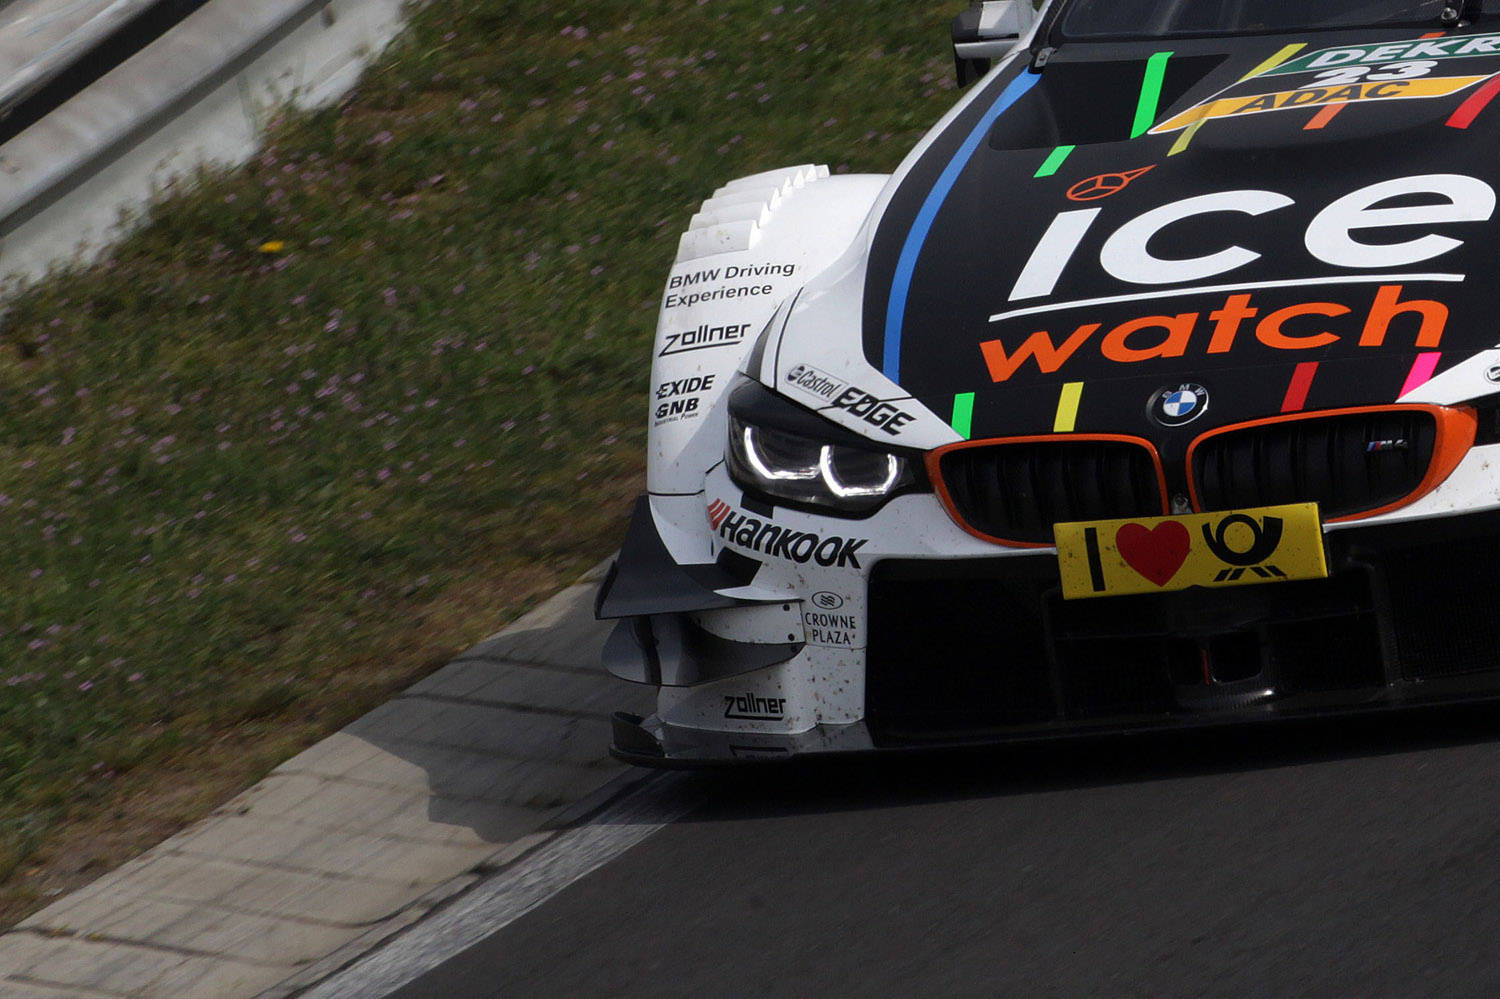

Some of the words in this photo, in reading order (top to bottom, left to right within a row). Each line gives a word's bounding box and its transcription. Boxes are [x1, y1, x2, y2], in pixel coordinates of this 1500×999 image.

[1302, 60, 1438, 88] 23
[1240, 80, 1411, 114] ADAC
[1008, 165, 1497, 301] ice
[669, 268, 721, 289] BMW
[724, 262, 796, 280] Driving
[664, 284, 773, 309] Experience
[979, 285, 1449, 383] watch
[656, 374, 716, 400] EXIDE
[655, 398, 700, 419] GNB
[797, 368, 842, 398] Castrol
[831, 386, 917, 436] EDGE
[1084, 527, 1107, 592] I
[805, 612, 856, 629] CROWNE
[812, 629, 851, 645] PLAZA
